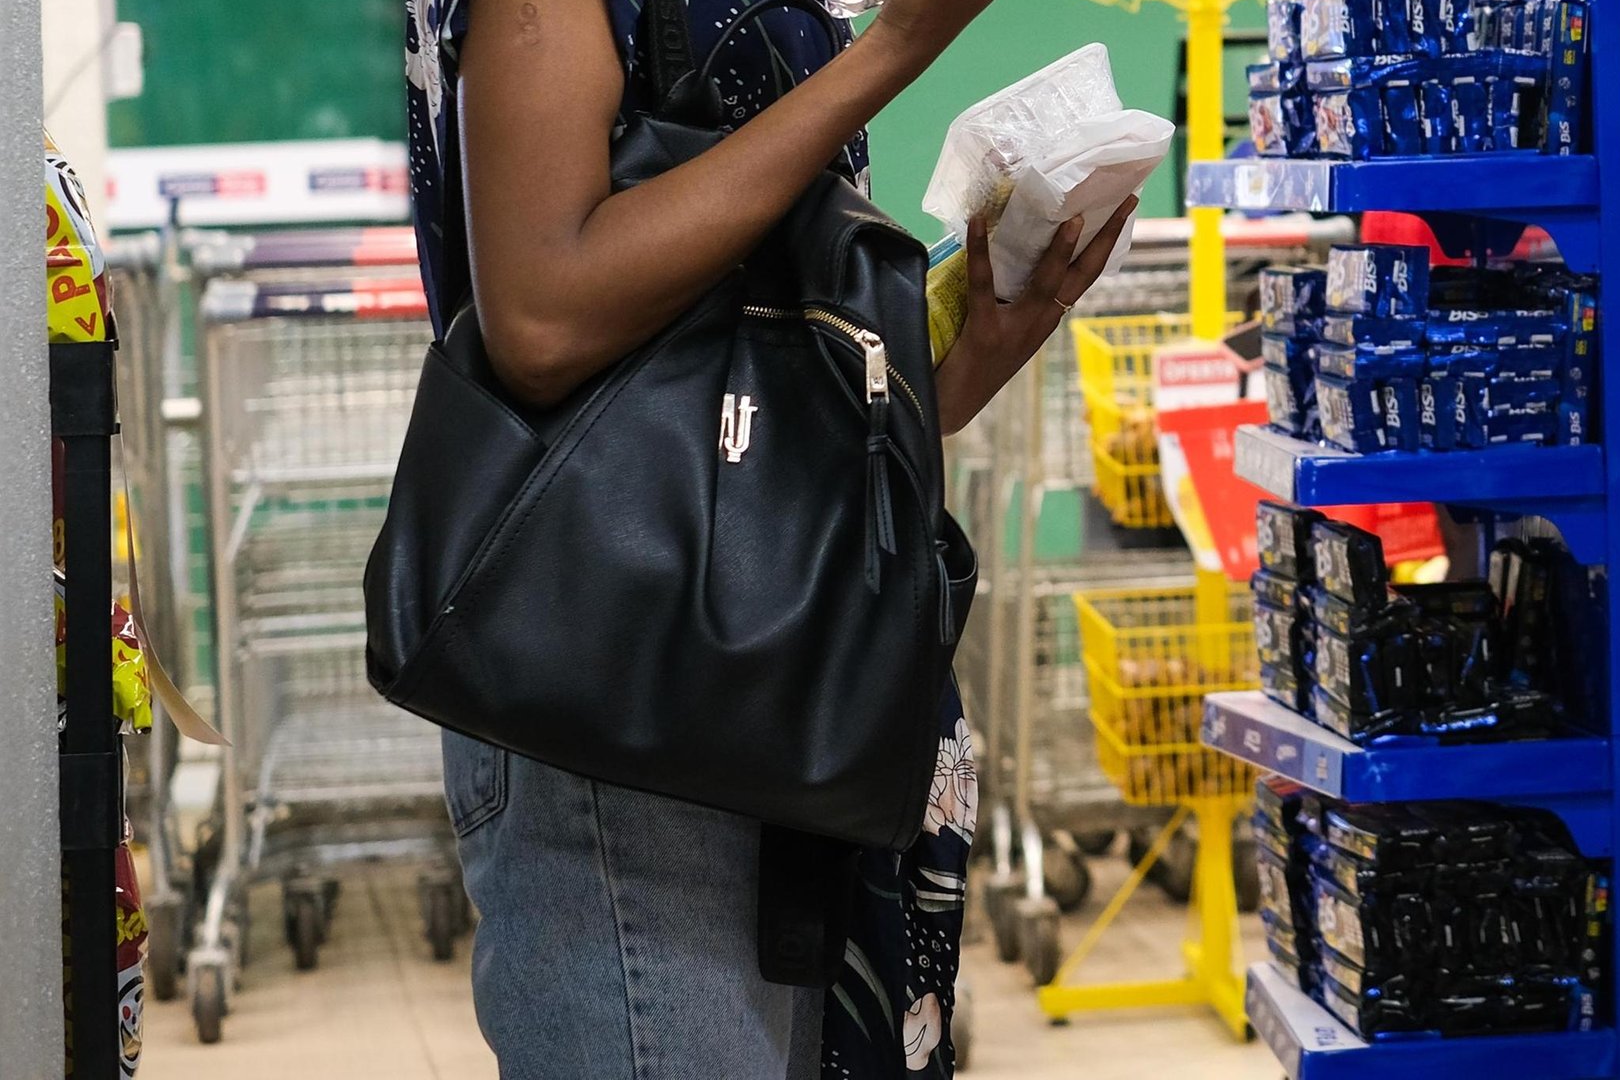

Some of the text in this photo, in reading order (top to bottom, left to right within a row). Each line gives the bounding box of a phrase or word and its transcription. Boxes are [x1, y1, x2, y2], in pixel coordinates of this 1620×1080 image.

[1412, 4, 1423, 34] BIS
[1374, 55, 1401, 66] BIS
[1559, 121, 1571, 143] BIS
[1365, 261, 1377, 293] BIS
[1449, 310, 1478, 322] BIS
[1385, 395, 1401, 428] BIS
[1422, 391, 1436, 426] BIS
[1456, 392, 1465, 423] BIS
[1570, 411, 1582, 434] BIS
